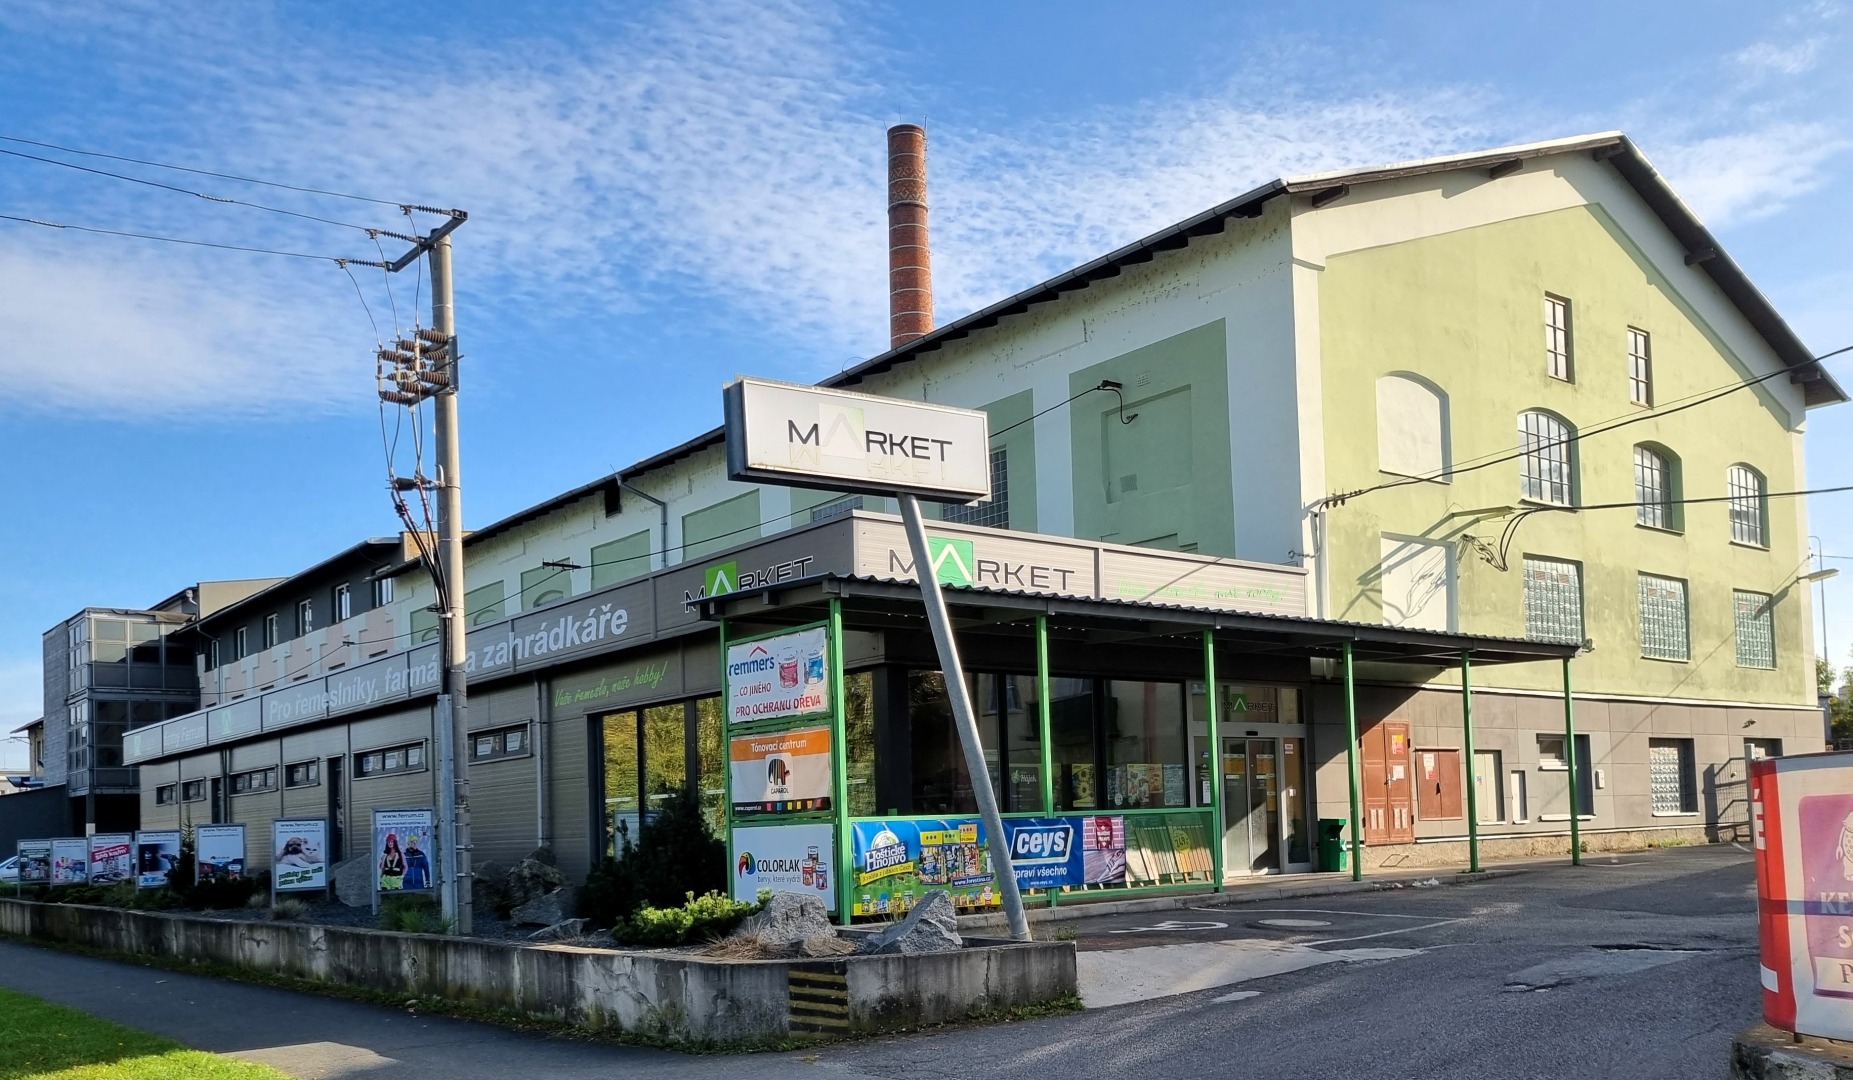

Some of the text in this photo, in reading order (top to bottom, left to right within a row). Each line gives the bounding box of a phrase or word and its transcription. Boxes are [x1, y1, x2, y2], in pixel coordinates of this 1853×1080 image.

[788, 413, 953, 462] MARKET
[269, 603, 629, 723] Pro řemeslníky, farmá a zahrádkáře
[728, 656, 775, 677] remmers
[611, 676, 632, 693] naše
[633, 660, 669, 690] hobby!
[739, 685, 749, 697] CO
[749, 681, 772, 697] JINÉHO
[735, 694, 822, 718] PRO OCHRANU DŘEVA
[751, 739, 807, 753] Tónovací centrum
[1016, 829, 1067, 858] ceys
[756, 859, 801, 873] COLORLAK
[865, 842, 906, 872] Hoštické
[757, 874, 772, 885] barvy,
[772, 873, 786, 884] které
[1036, 865, 1068, 878] všechno
